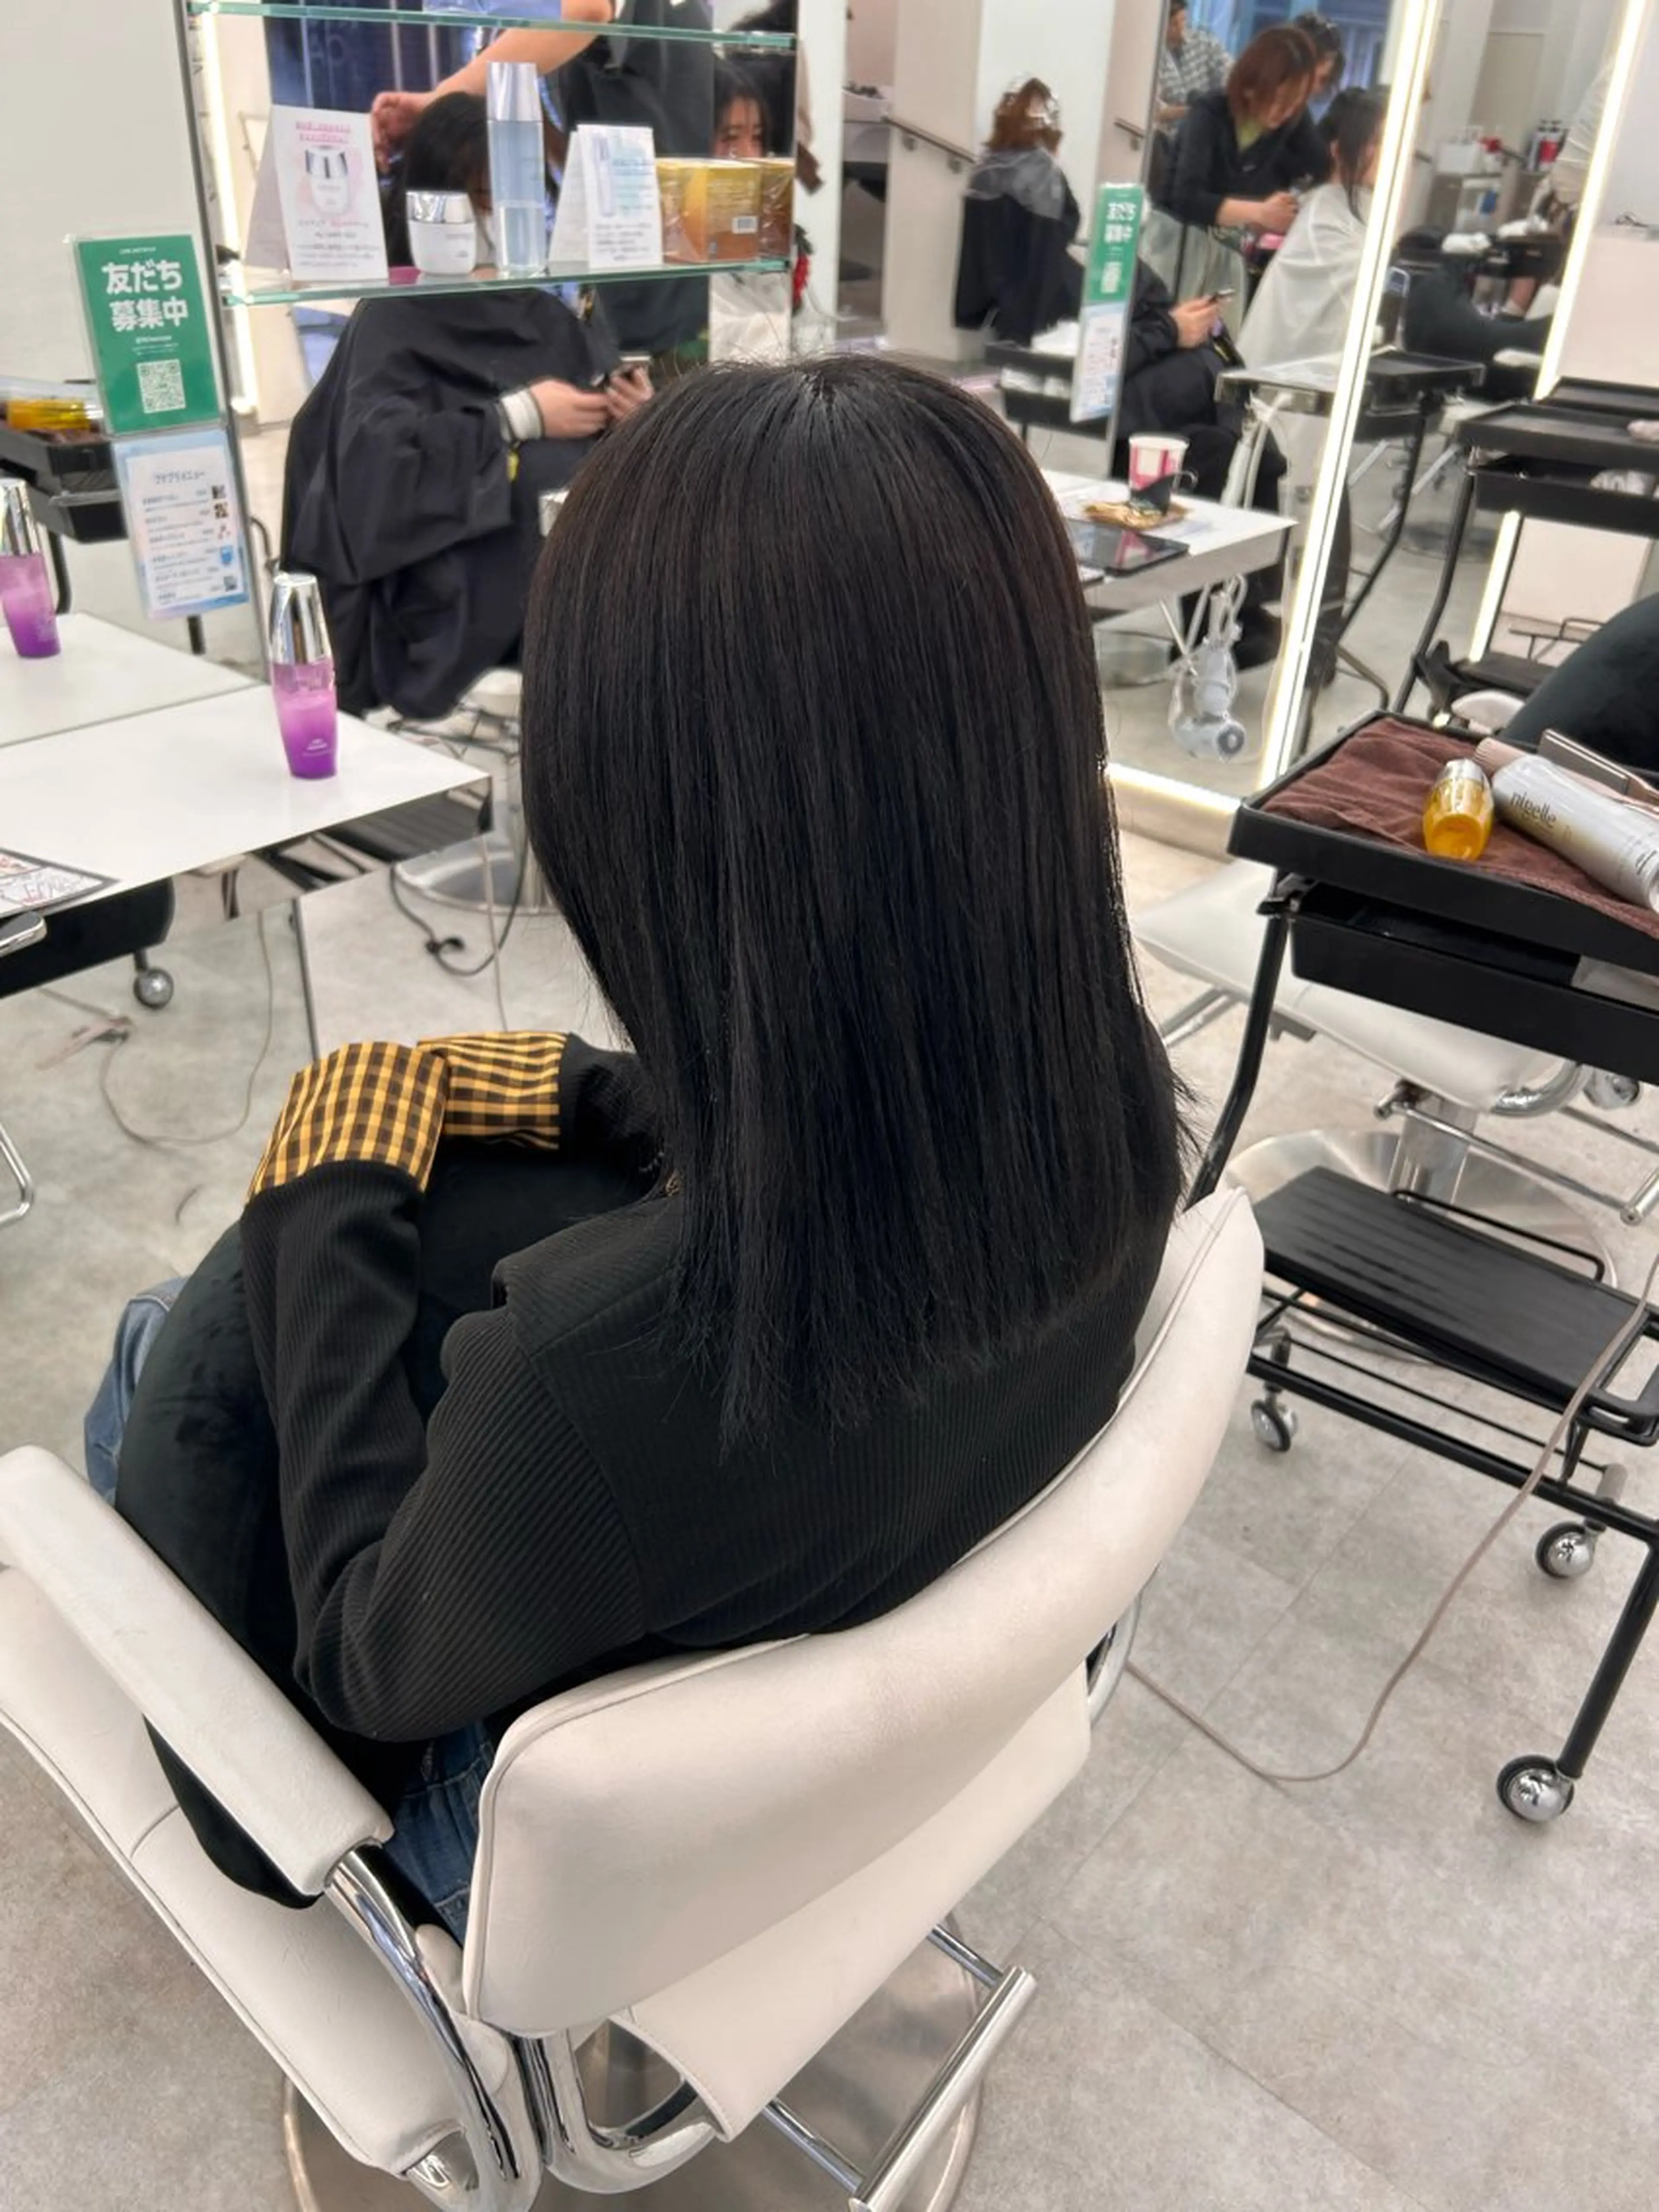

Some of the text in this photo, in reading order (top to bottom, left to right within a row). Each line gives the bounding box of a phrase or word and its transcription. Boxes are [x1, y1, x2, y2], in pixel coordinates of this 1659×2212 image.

[101, 258, 182, 295] 友だち
[109, 296, 189, 332] 募集中
